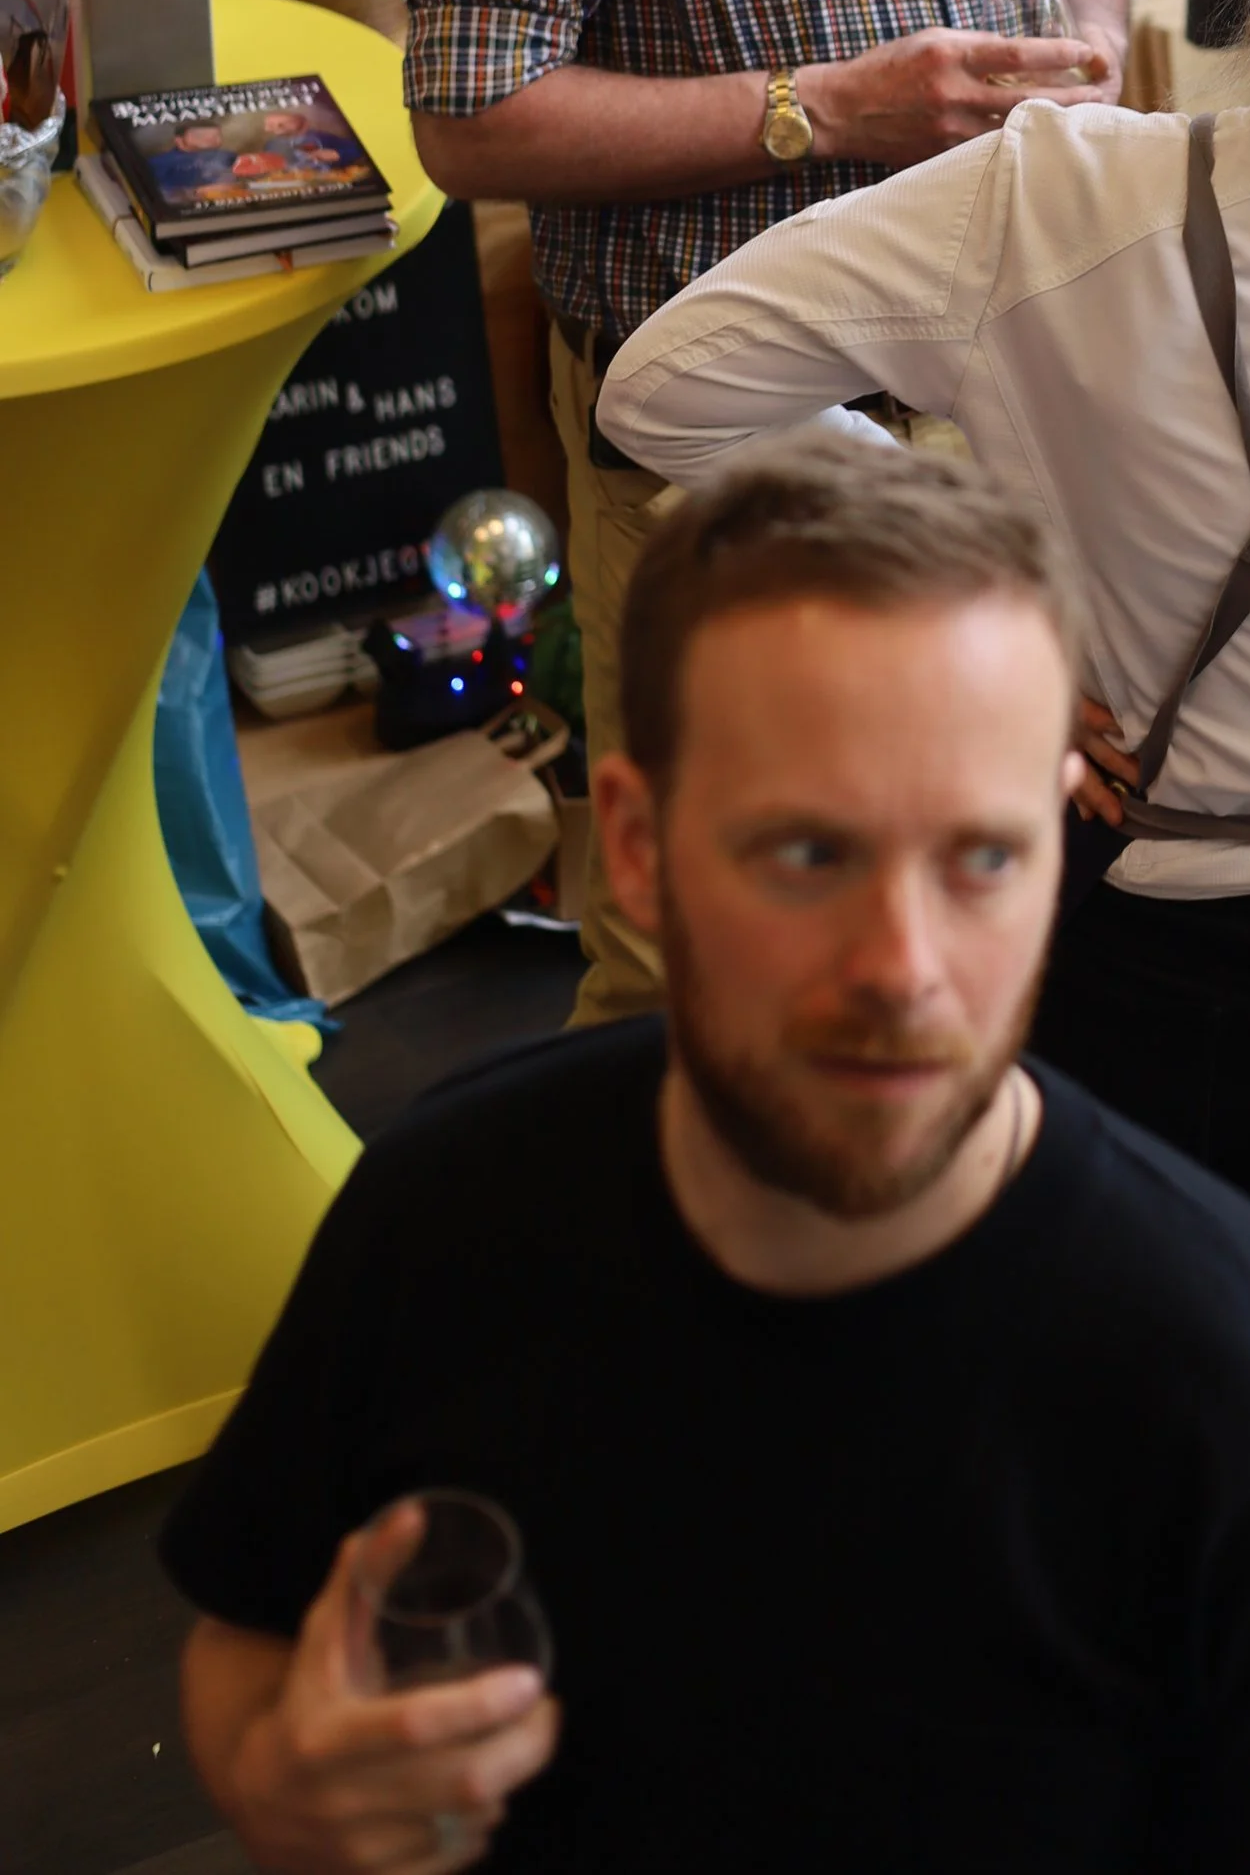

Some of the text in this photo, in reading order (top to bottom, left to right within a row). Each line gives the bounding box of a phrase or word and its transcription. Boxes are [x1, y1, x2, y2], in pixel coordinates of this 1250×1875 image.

[131, 94, 314, 128] MAASTRICHT
[269, 375, 458, 422] ARIN & HANS
[262, 424, 446, 499] EN FRIENDS
